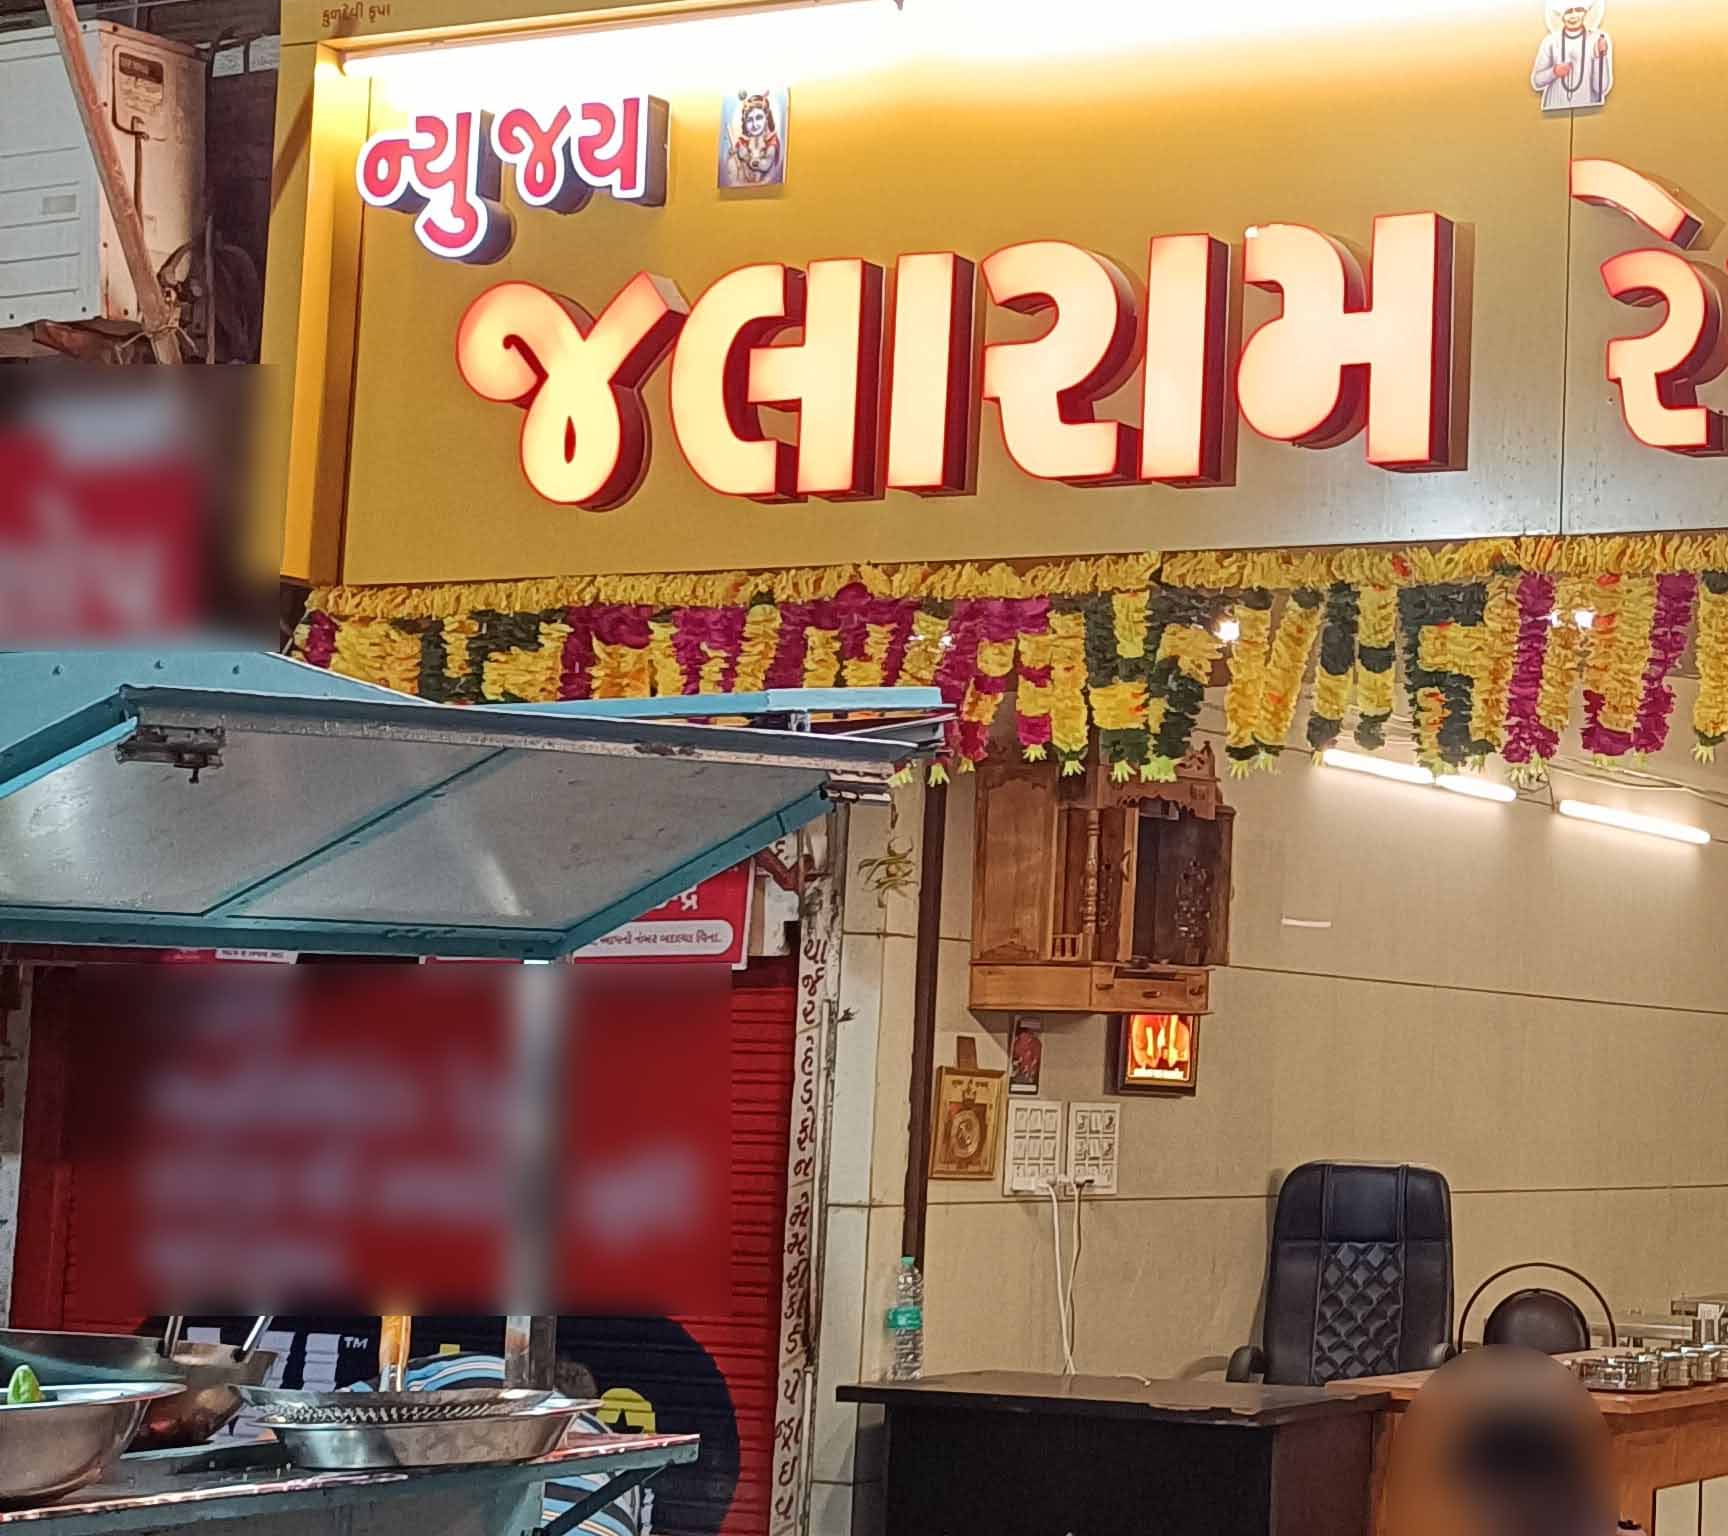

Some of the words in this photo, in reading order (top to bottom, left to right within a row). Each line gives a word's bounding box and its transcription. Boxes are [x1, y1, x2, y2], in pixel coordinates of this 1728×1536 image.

[356, 108, 490, 260] ન્યુ
[492, 94, 655, 206] જય
[456, 210, 1448, 507] જલારામ
